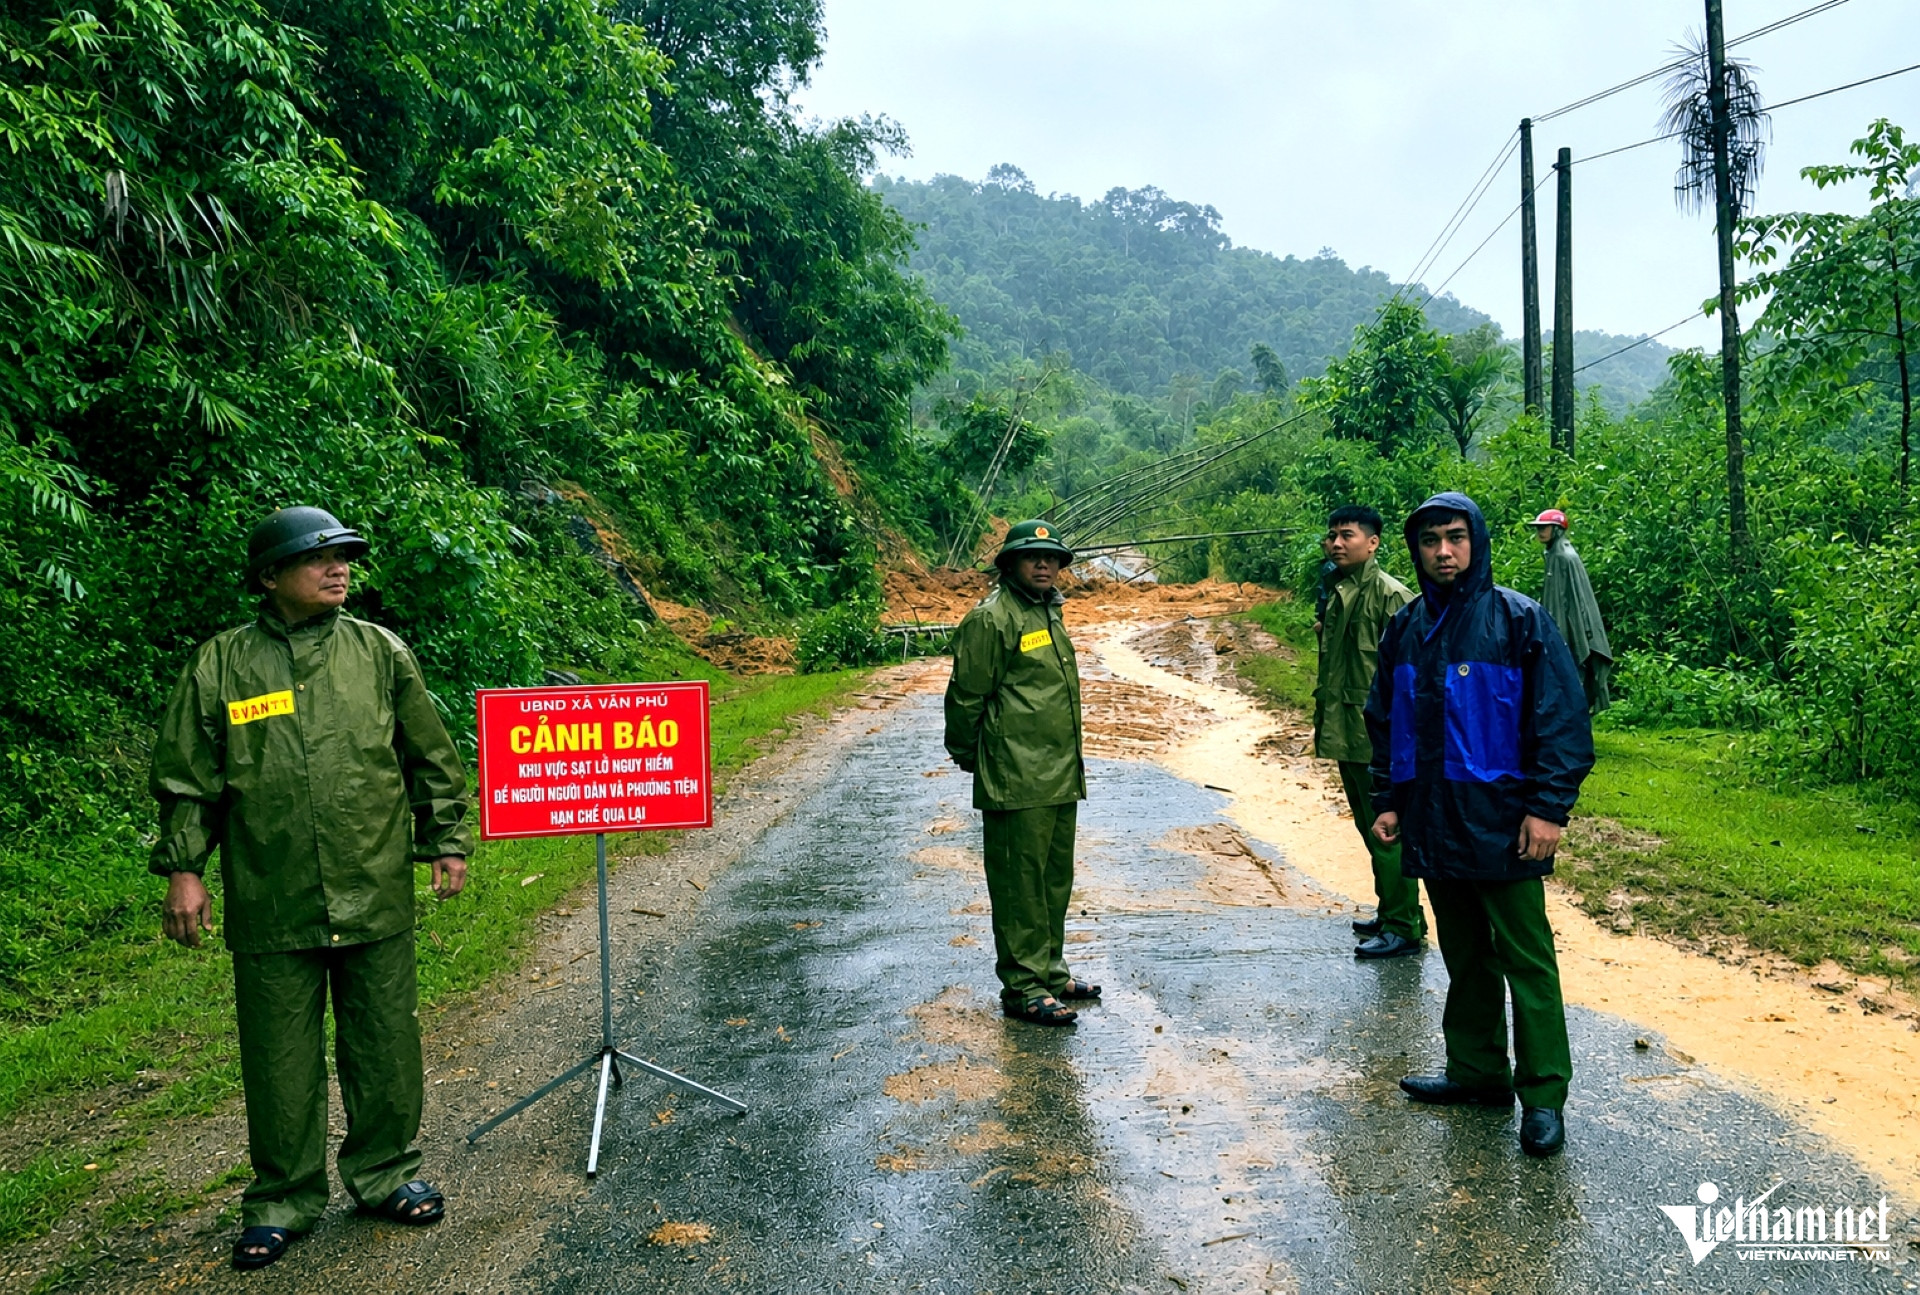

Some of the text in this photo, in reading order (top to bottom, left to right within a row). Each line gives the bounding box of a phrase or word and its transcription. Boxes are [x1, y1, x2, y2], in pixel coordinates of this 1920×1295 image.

[520, 699, 566, 712] UBND
[510, 714, 679, 754] CẢNH BÁO
[518, 763, 541, 778] KHU
[571, 760, 592, 779] SẠT
[612, 757, 642, 774] NGUY
[550, 809, 574, 828] HẠN
[602, 808, 626, 824] QUA
[628, 806, 646, 823] LẠI
